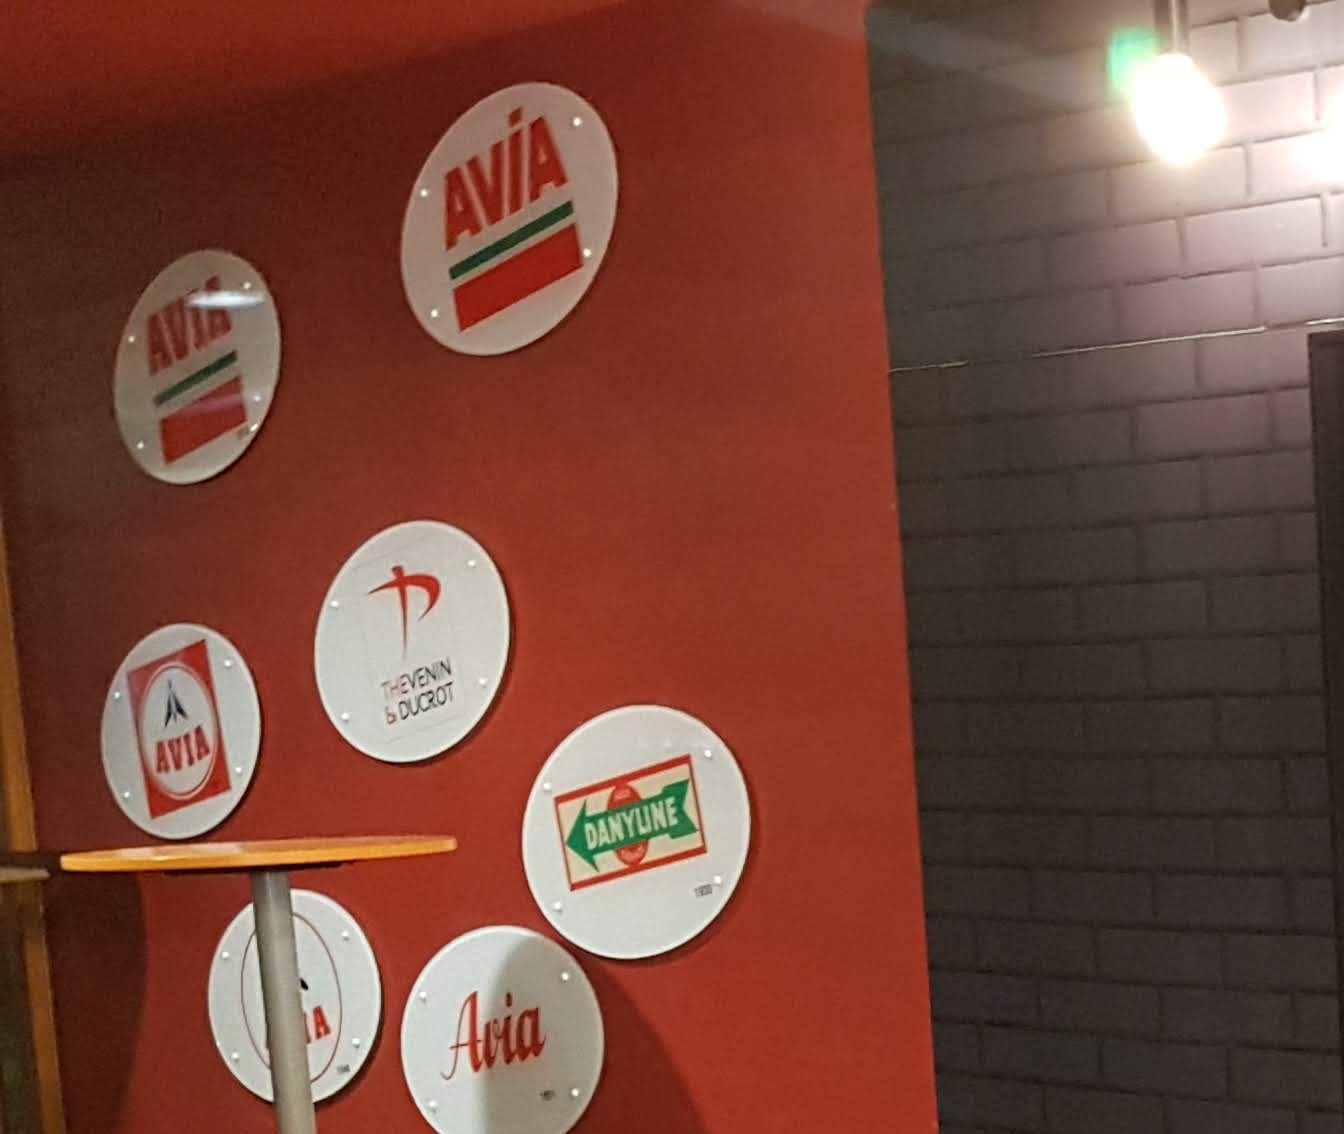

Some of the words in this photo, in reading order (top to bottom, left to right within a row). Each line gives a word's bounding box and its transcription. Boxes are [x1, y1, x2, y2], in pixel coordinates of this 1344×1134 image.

[444, 107, 568, 251] AVIA
[381, 656, 453, 701] THEVENIN
[398, 681, 454, 721] DUCROT
[156, 724, 210, 773] AVIA
[584, 796, 679, 851] DANYLINE
[441, 991, 548, 1081] Avia
